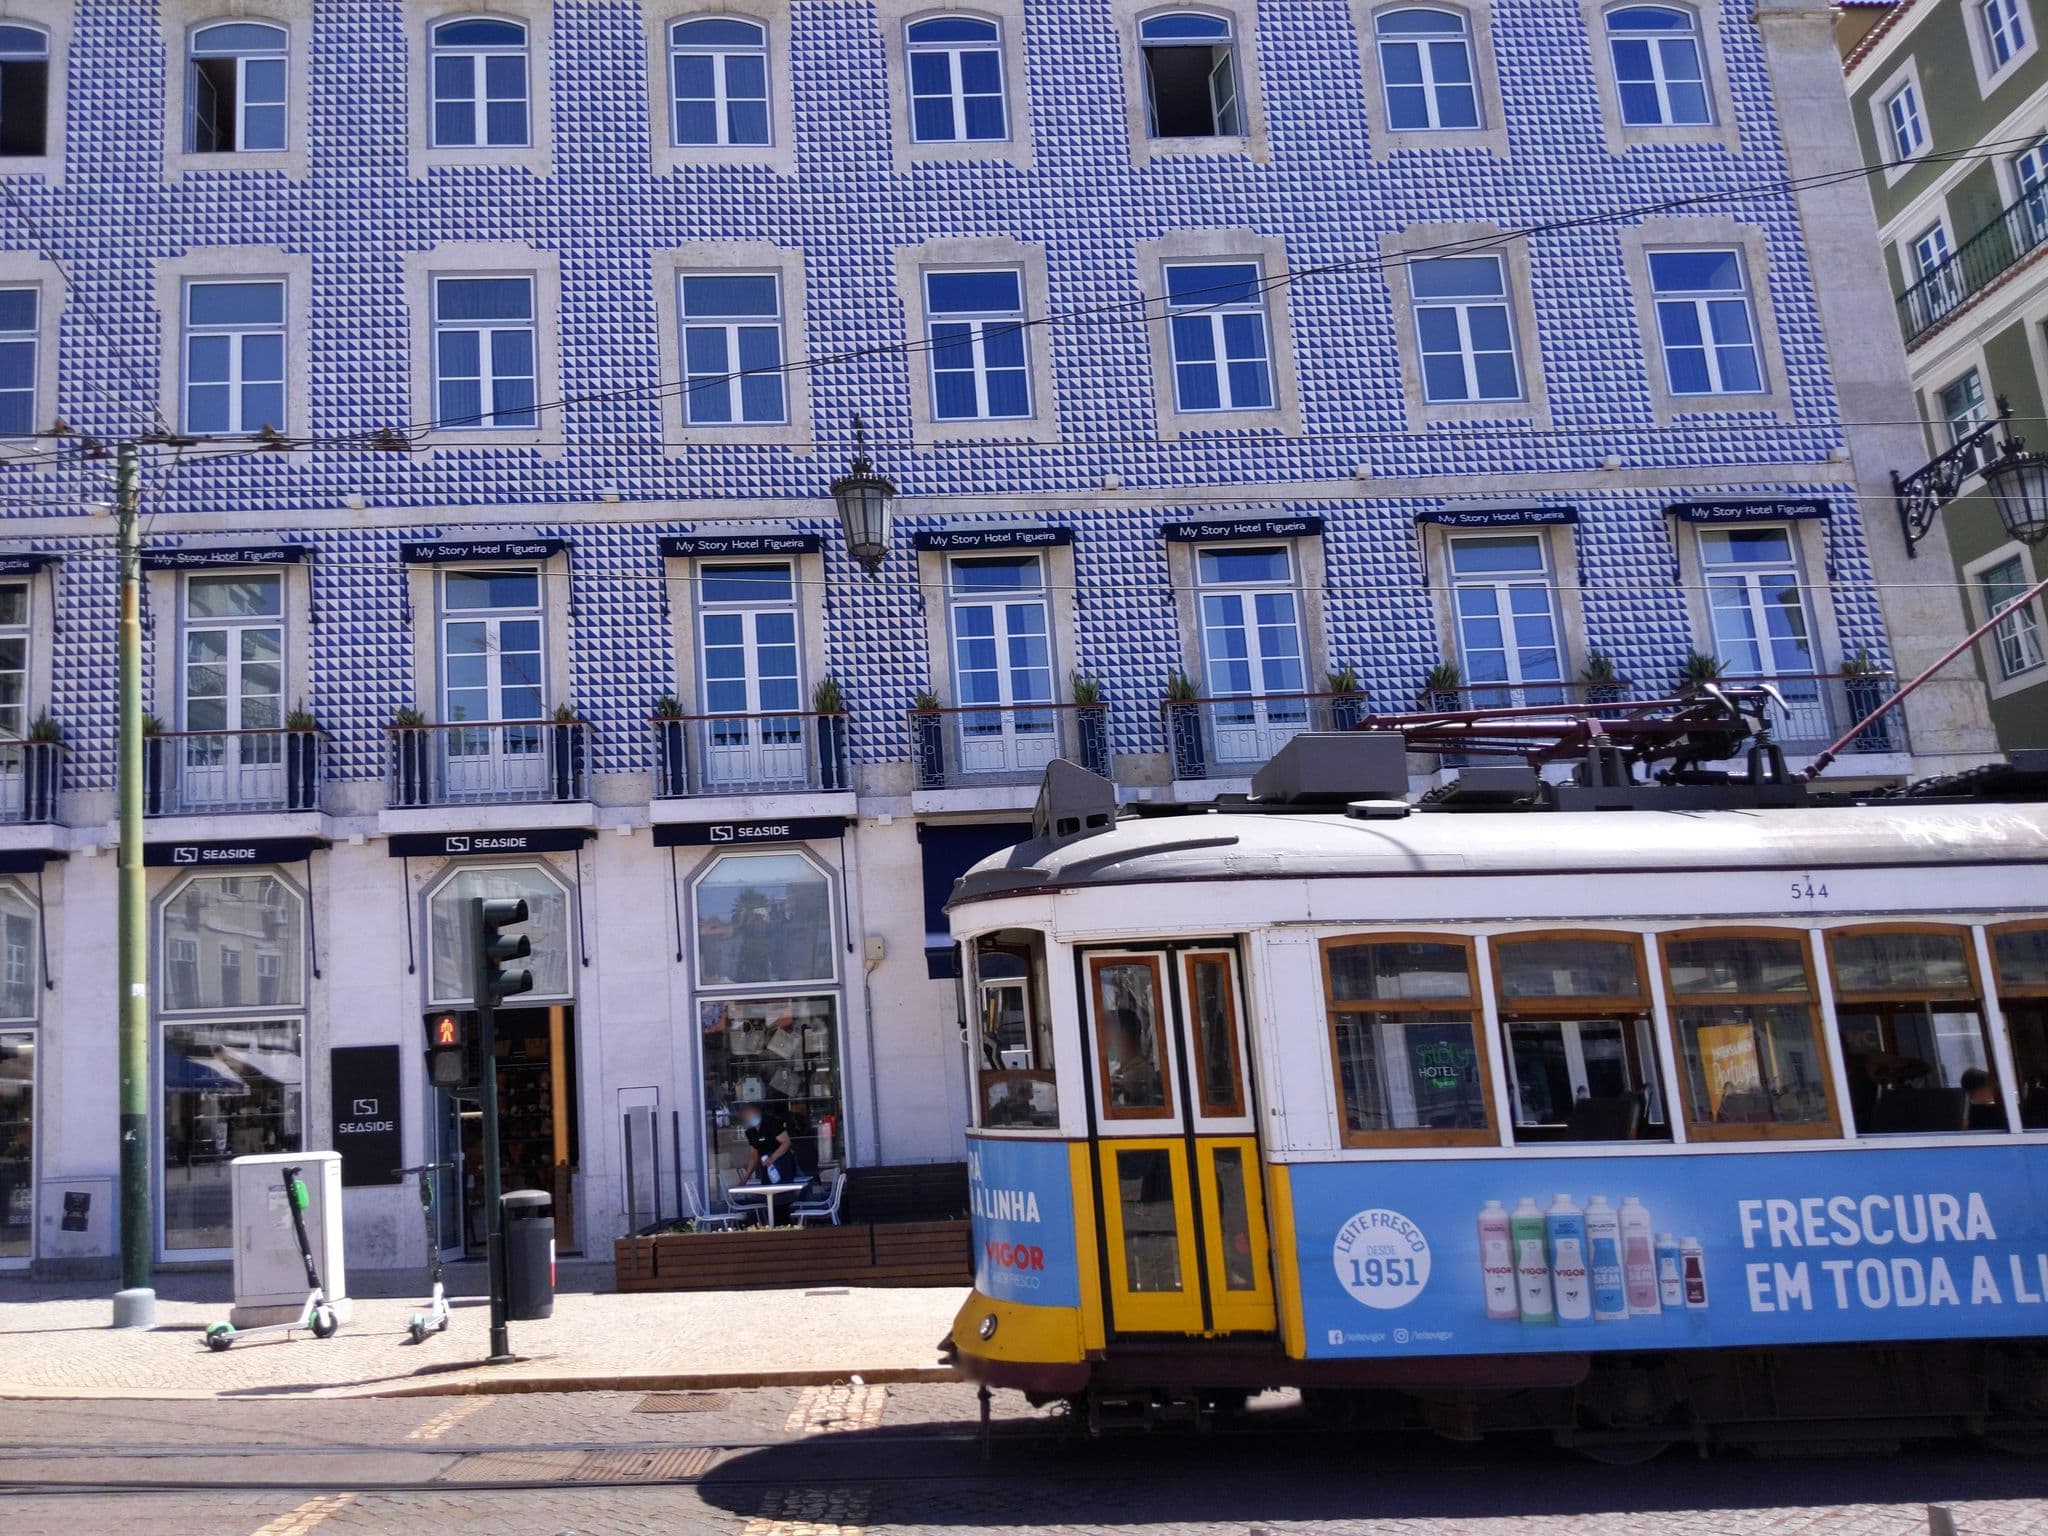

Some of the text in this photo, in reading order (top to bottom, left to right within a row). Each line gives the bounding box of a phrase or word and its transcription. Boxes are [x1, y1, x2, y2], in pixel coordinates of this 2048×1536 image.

[1438, 511, 1565, 524] My Story Hotel Figueira
[1692, 504, 1817, 519] My Story Hotel Figueira
[1179, 522, 1306, 538] My Story Hotel Figueira
[676, 538, 805, 552] My Story Hotel Figueira
[930, 532, 1056, 546] My Story Hotel Figueira
[153, 550, 285, 565] My Story Hotel Figueira
[416, 543, 547, 558] My Story Hotel Figueira
[738, 825, 790, 837] SEASIDE
[474, 837, 527, 848] SEASIDE
[202, 849, 256, 859] SEASIDE
[1791, 882, 1830, 900] 544
[339, 1121, 394, 1133] SEASIDE
[985, 1187, 1041, 1223] LINHA
[1738, 1192, 1998, 1249] FRESCURA
[1336, 1213, 1425, 1254] LEITE FRESCO
[985, 1241, 1045, 1272] VIGOR
[1366, 1244, 1397, 1256] DESDE
[1350, 1258, 1420, 1287] 1951
[1746, 1261, 1813, 1313] EM
[1821, 1257, 1961, 1309] TODA
[1971, 1255, 2003, 1305] A
